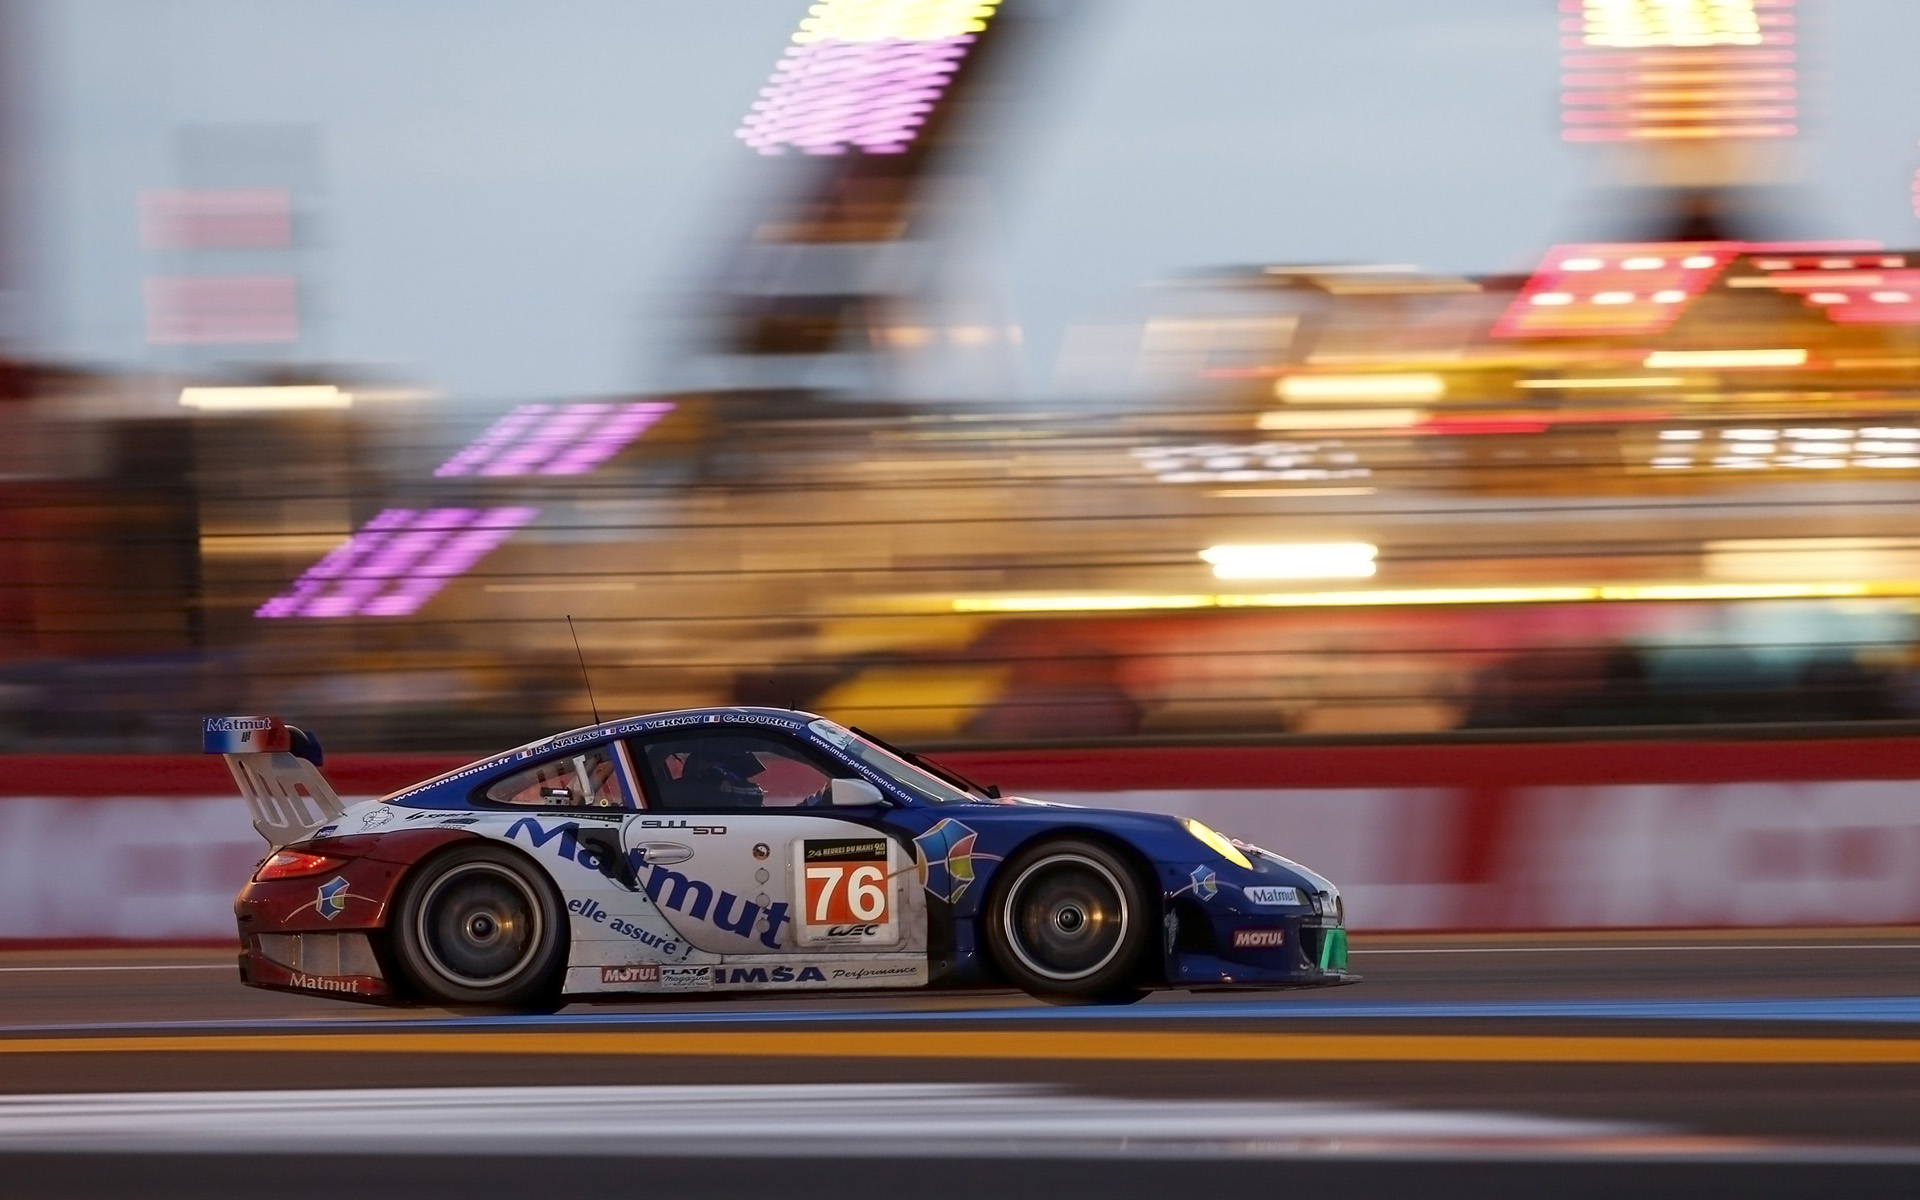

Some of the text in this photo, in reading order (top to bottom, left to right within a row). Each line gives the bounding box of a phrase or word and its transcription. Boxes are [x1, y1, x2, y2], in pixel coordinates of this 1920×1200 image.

[206, 717, 272, 732] Matmut
[645, 715, 701, 729] VERNAY
[723, 714, 805, 730] C.BOURRET
[535, 730, 601, 755] R. NARAC
[809, 734, 914, 804] www.imsa-performance.com
[393, 756, 511, 803] www.matmut.fr
[692, 826, 727, 835] 50
[807, 848, 823, 859] 24
[822, 845, 846, 855] HEURES
[845, 843, 856, 853] DU
[855, 841, 875, 852] MANS
[503, 817, 792, 950] Matmut
[807, 866, 885, 921] 76
[1253, 889, 1296, 903] Matmut
[567, 897, 608, 924] elle
[681, 944, 693, 961] !
[828, 924, 879, 936] WEC
[1235, 933, 1283, 945] MOTUL
[289, 973, 358, 993] Matmut
[604, 968, 657, 982] MOTUL
[715, 967, 918, 984] IMSA Performance
